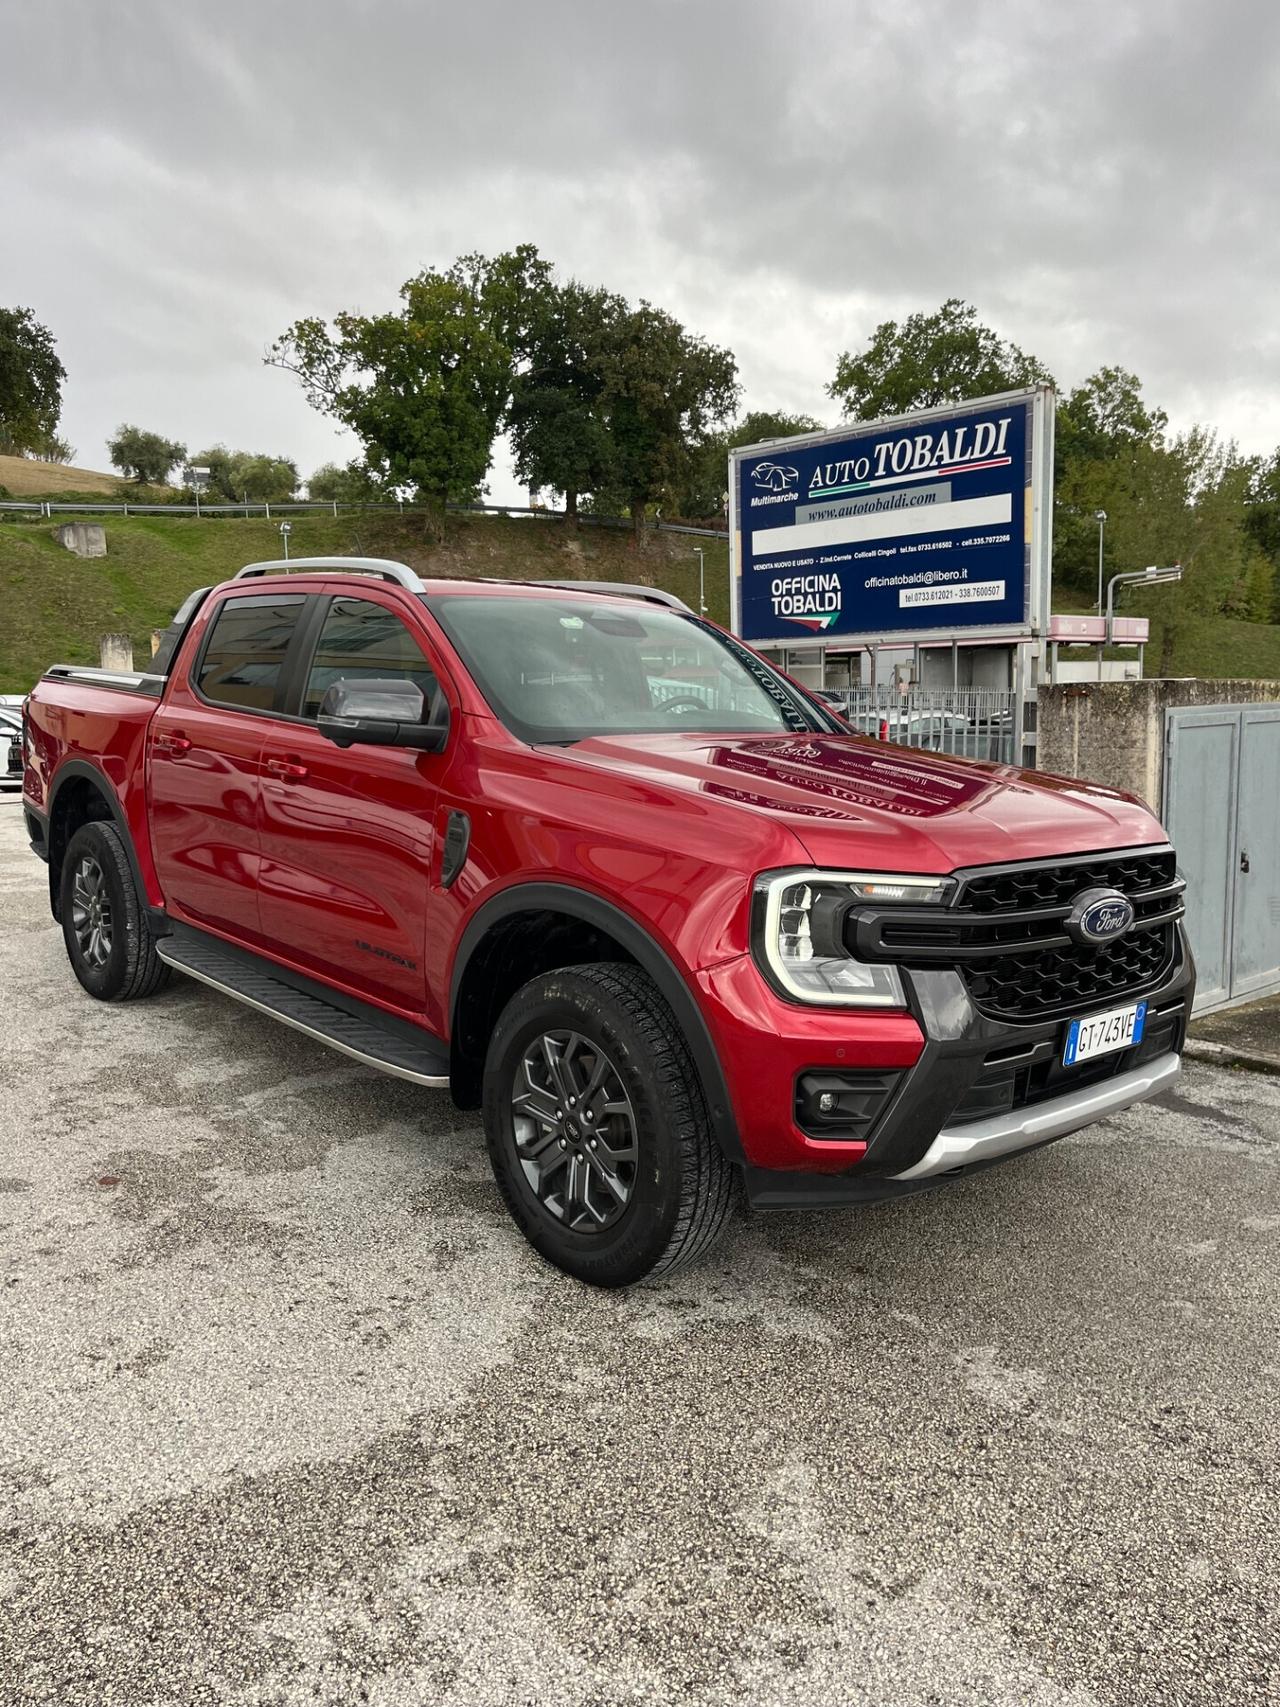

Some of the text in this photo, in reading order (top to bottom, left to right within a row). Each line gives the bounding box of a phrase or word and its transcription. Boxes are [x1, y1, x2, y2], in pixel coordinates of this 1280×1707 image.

[809, 418, 1012, 488] AUTO TOBALDI
[751, 492, 799, 507] Multimarche
[808, 491, 937, 522] www.autotobaldi.com
[753, 563, 773, 571] VENDITA
[774, 561, 792, 569] NUOVO
[797, 558, 814, 566] USATO
[877, 547, 897, 557] Cingoli
[771, 574, 841, 596] OFFICINA
[864, 568, 968, 589] officinatobaldi@libero.it
[771, 591, 842, 615] TOBALDI
[905, 590, 953, 603] tel.0733.612021
[959, 586, 1000, 599] 338.7600507
[1096, 907, 1126, 932] Ford
